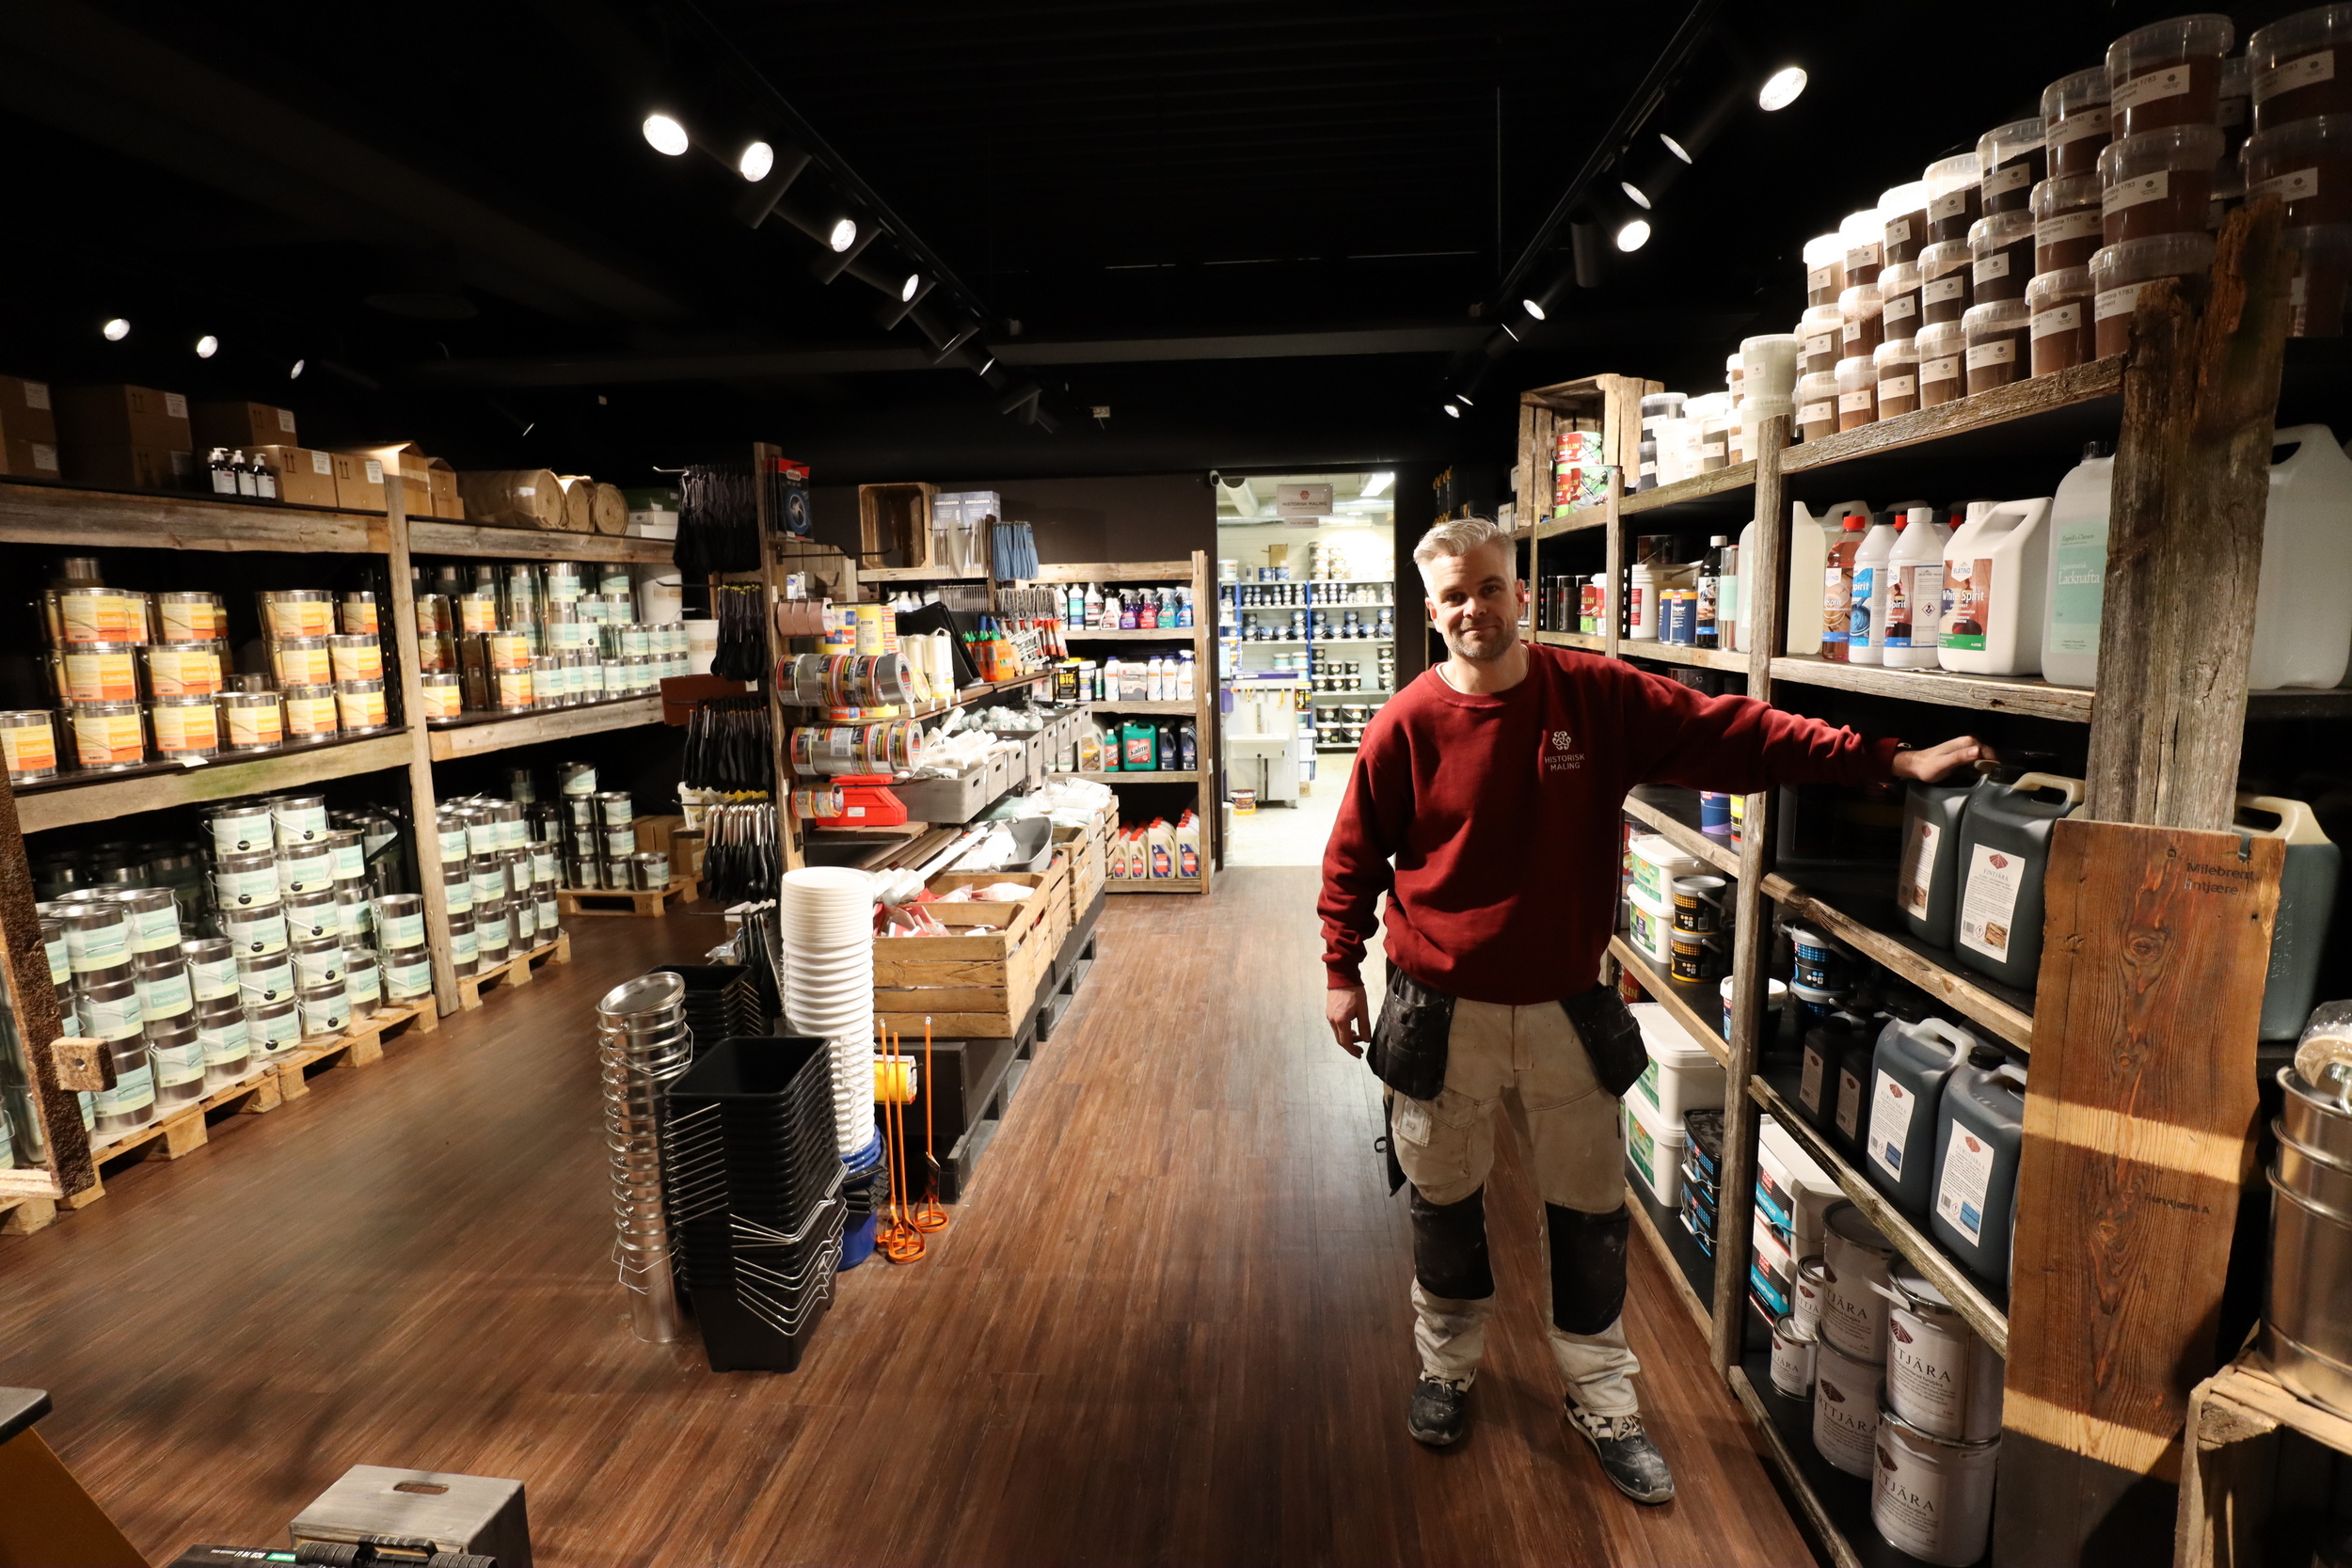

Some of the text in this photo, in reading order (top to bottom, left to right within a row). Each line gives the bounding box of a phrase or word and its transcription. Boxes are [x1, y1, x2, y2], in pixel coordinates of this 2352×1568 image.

[2058, 569, 2101, 585] Lacknafta
[1852, 582, 1869, 593] pirit
[1942, 590, 1985, 604] White Spirit
[1059, 674, 1074, 684] BIG
[1544, 753, 1586, 764] HISTORISK
[1549, 762, 1581, 771] MALING
[1983, 868, 2009, 881] FINTJÄRA
[2185, 878, 2239, 895] fintjære
[2202, 1206, 2210, 1214] A
